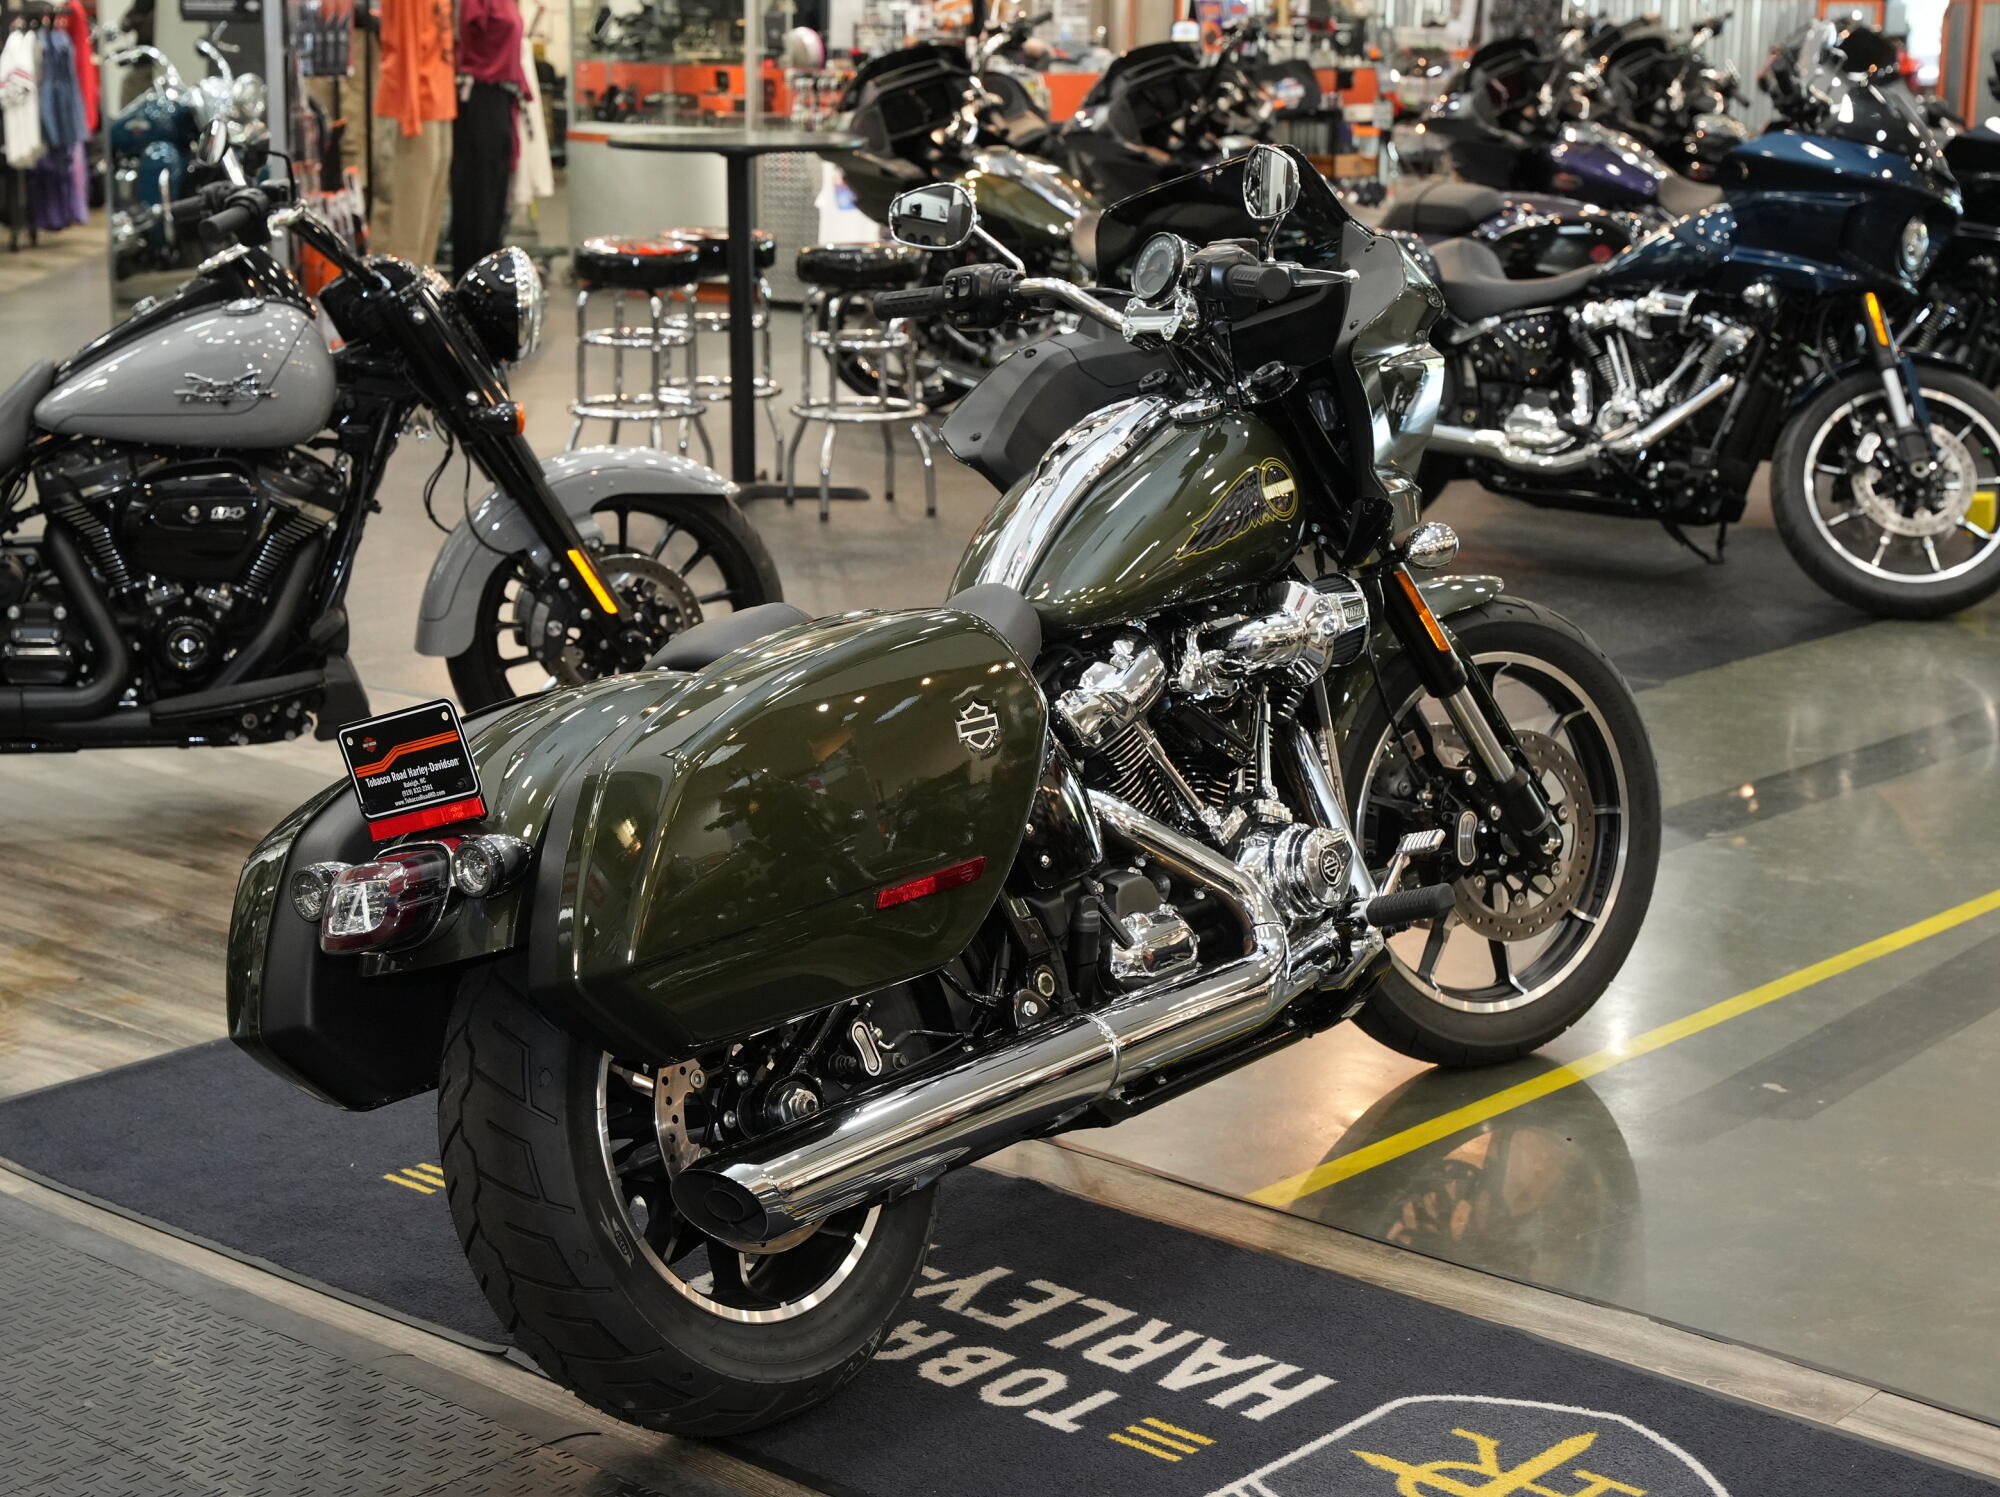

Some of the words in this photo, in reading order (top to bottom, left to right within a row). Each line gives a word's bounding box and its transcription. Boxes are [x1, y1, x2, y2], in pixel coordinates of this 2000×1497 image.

[365, 776, 391, 788] Tobacco
[391, 770, 407, 782] Road
[407, 758, 460, 777] Harley-Davidson
[402, 788, 414, 797] (919)
